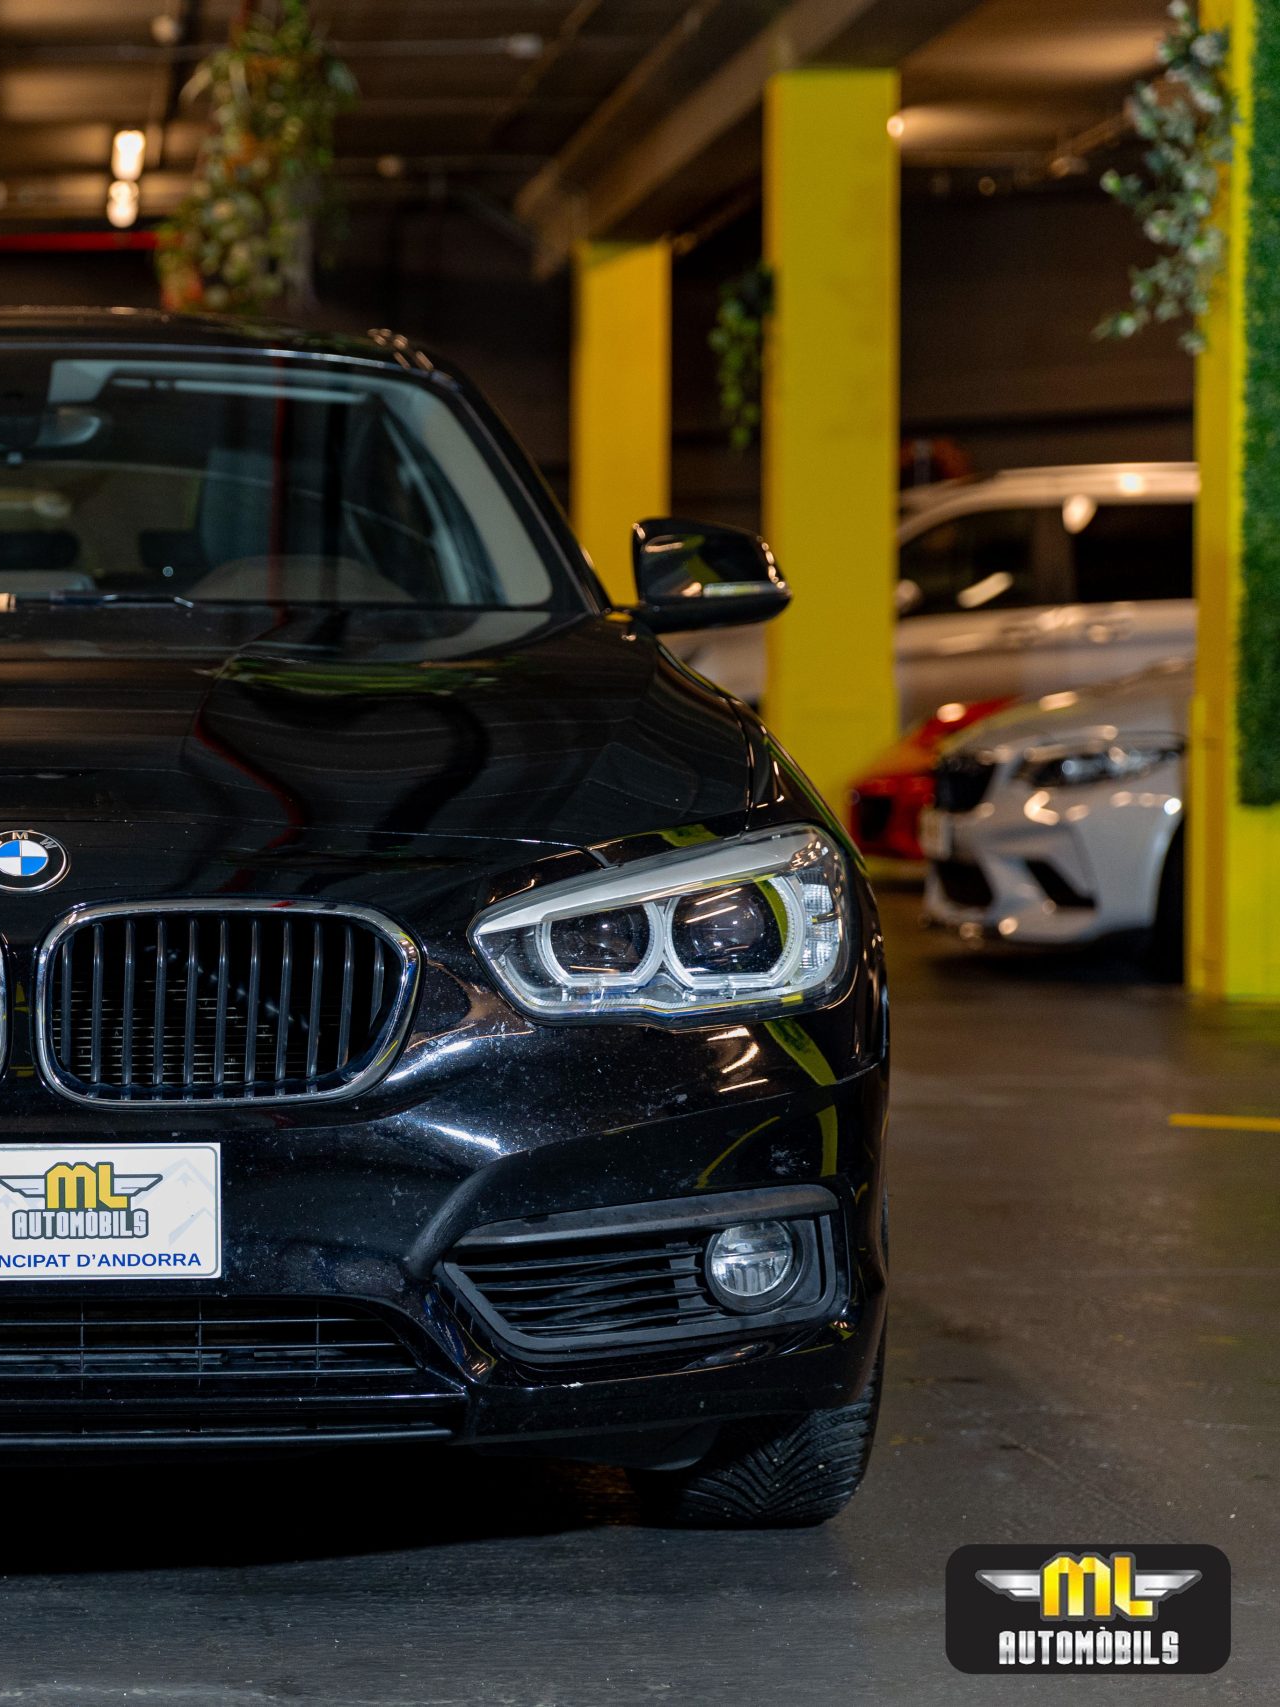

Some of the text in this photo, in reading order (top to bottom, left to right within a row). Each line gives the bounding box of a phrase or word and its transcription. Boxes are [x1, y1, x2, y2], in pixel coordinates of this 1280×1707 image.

[46, 1164, 128, 1209] ML
[14, 1208, 147, 1238] AUTOMÒBILS
[77, 1253, 201, 1267] D’ANDORRA
